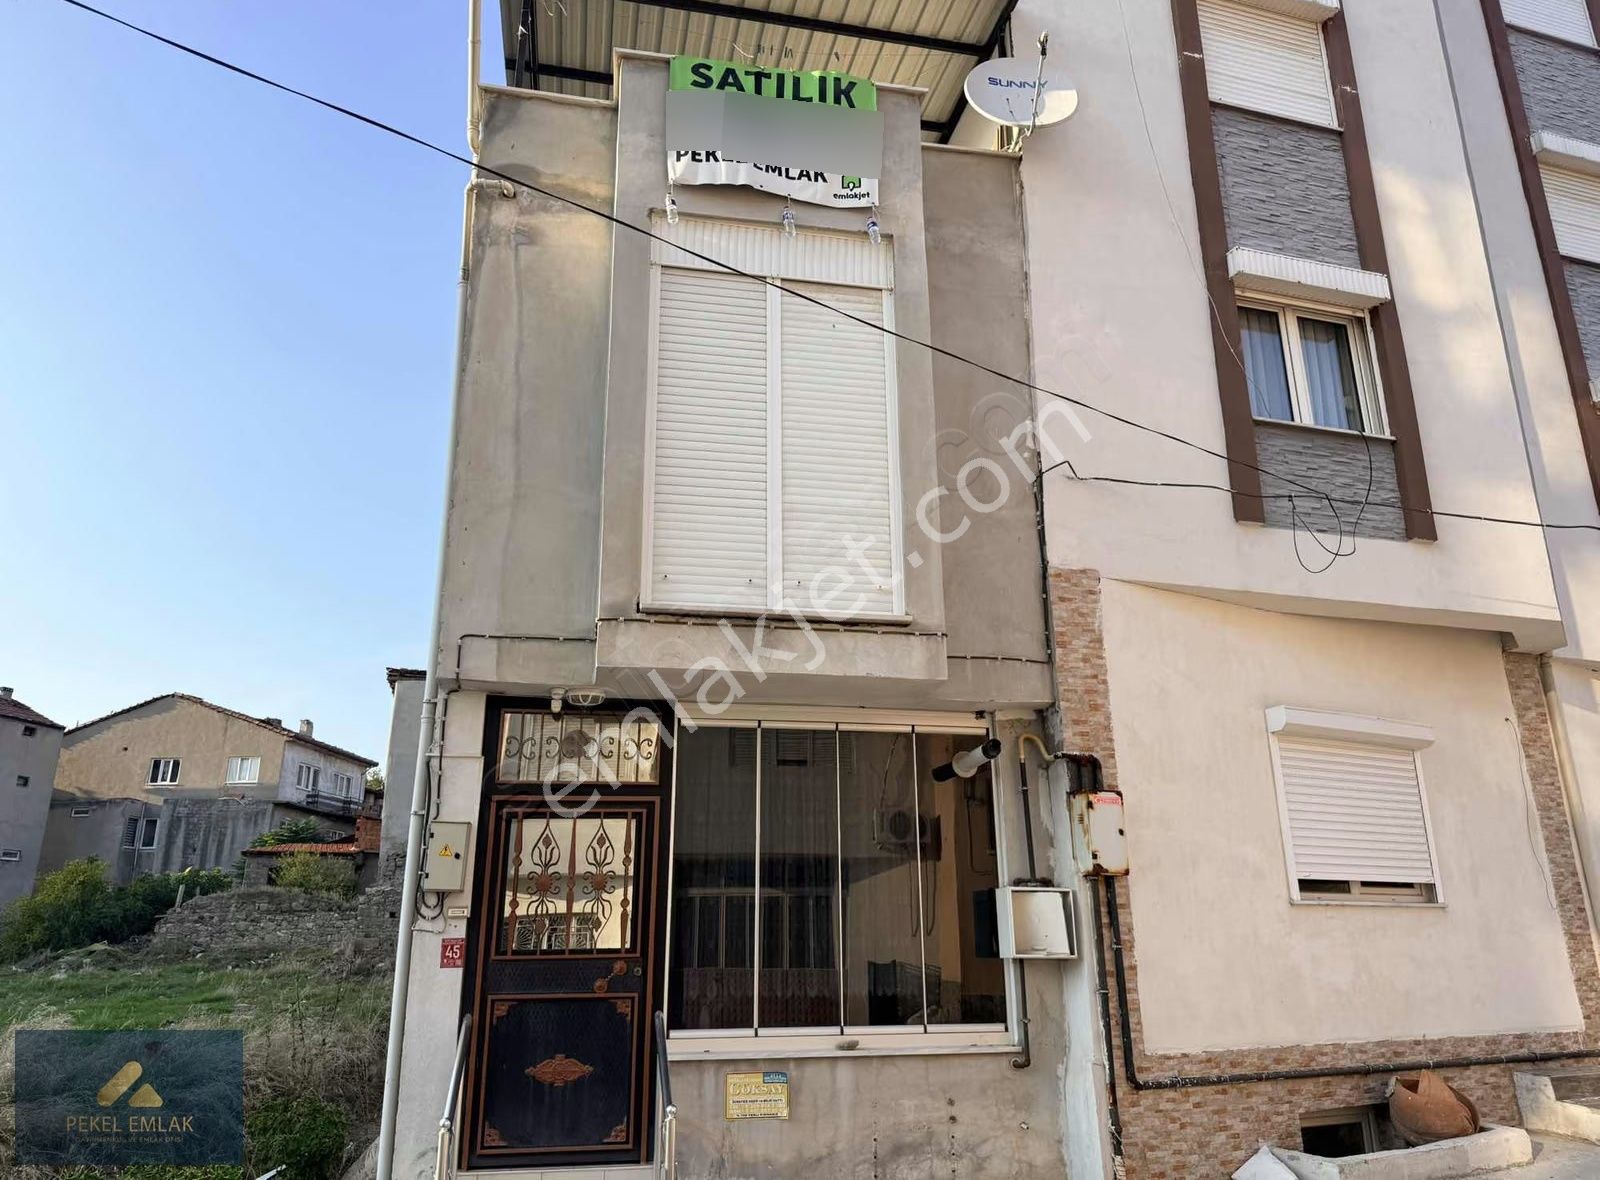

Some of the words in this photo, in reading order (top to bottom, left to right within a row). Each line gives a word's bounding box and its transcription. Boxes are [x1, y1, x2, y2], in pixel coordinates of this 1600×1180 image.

[690, 62, 858, 109] SATILIK
[987, 76, 1049, 89] SUNNY
[675, 150, 749, 164] PEK
[833, 191, 871, 201] emlakjet
[445, 944, 461, 959] 45
